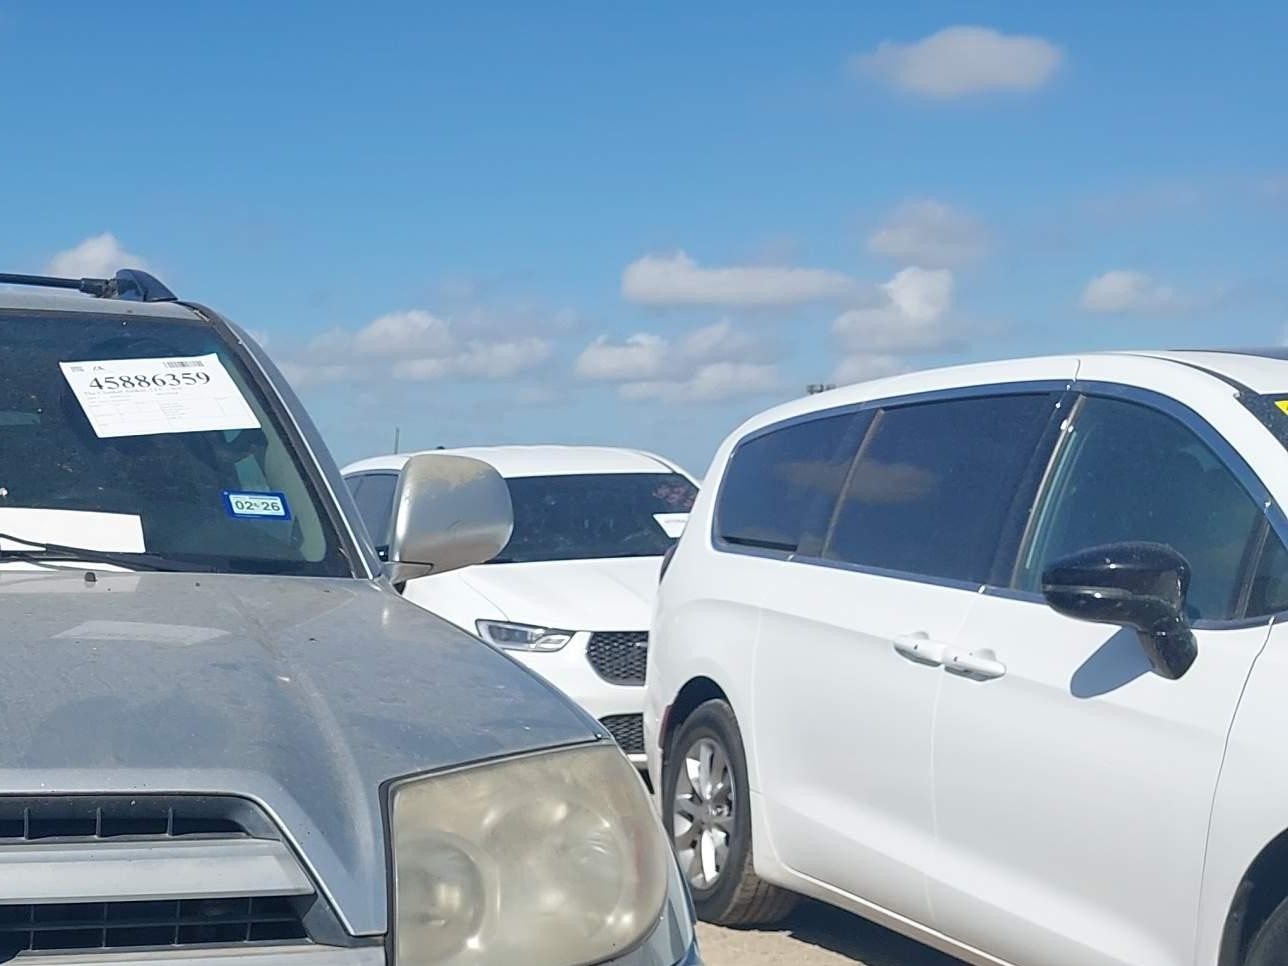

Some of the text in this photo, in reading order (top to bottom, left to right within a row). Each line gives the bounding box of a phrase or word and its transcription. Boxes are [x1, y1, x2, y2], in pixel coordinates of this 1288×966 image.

[88, 371, 211, 391] 45886359
[235, 500, 281, 512] 02 26
